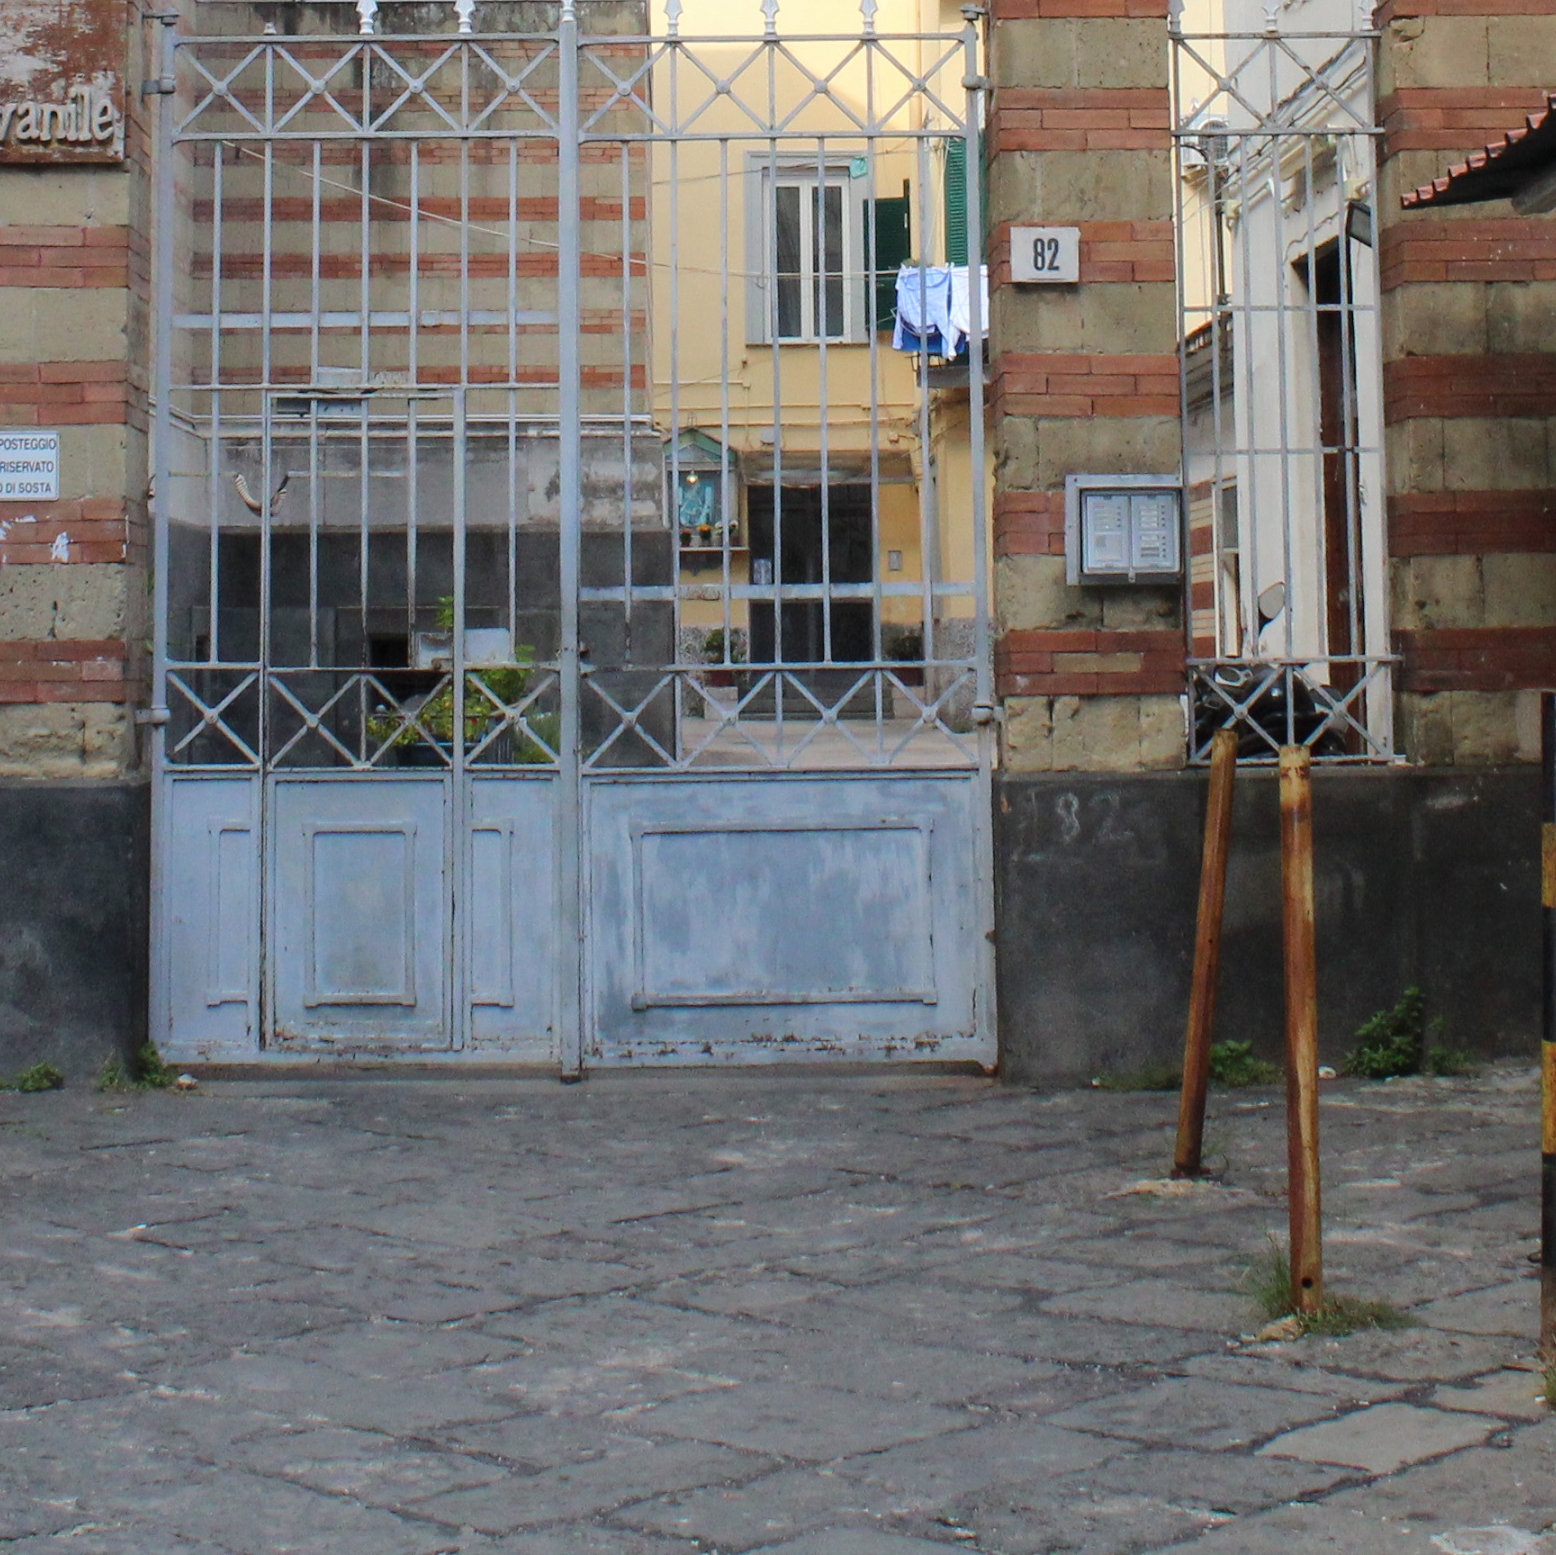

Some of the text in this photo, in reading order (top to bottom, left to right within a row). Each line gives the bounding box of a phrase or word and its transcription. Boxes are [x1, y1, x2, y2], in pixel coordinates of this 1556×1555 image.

[1033, 238, 1060, 271] 82
[0, 461, 54, 473] RISERVATO
[6, 482, 15, 494] DI
[18, 482, 51, 494] SOSTA
